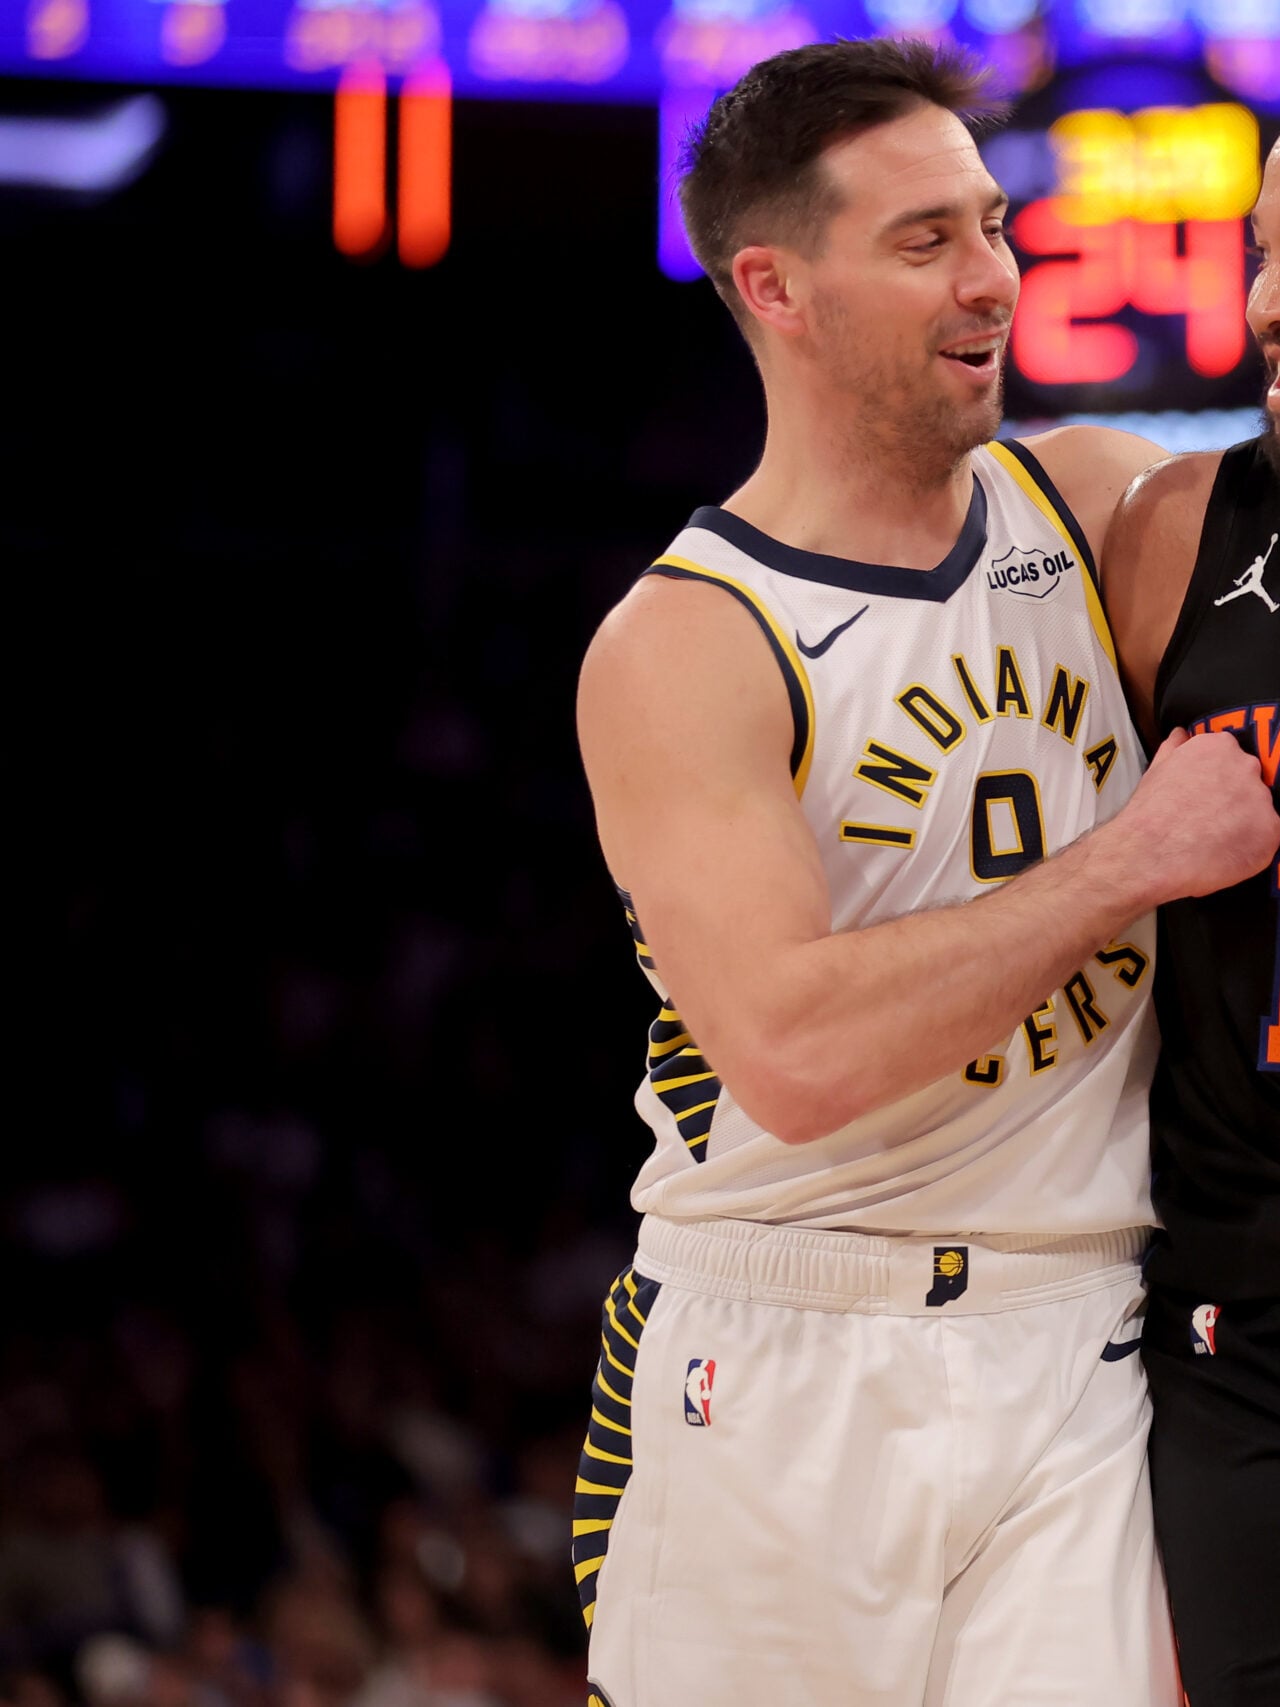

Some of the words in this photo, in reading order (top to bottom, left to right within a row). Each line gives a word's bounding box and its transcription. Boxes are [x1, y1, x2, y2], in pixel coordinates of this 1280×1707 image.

[1011, 197, 1247, 384] 24
[986, 562, 1040, 590] LUCAS
[1043, 550, 1075, 576] OIL
[839, 645, 1120, 850] INDIANA
[969, 768, 1048, 884] 0
